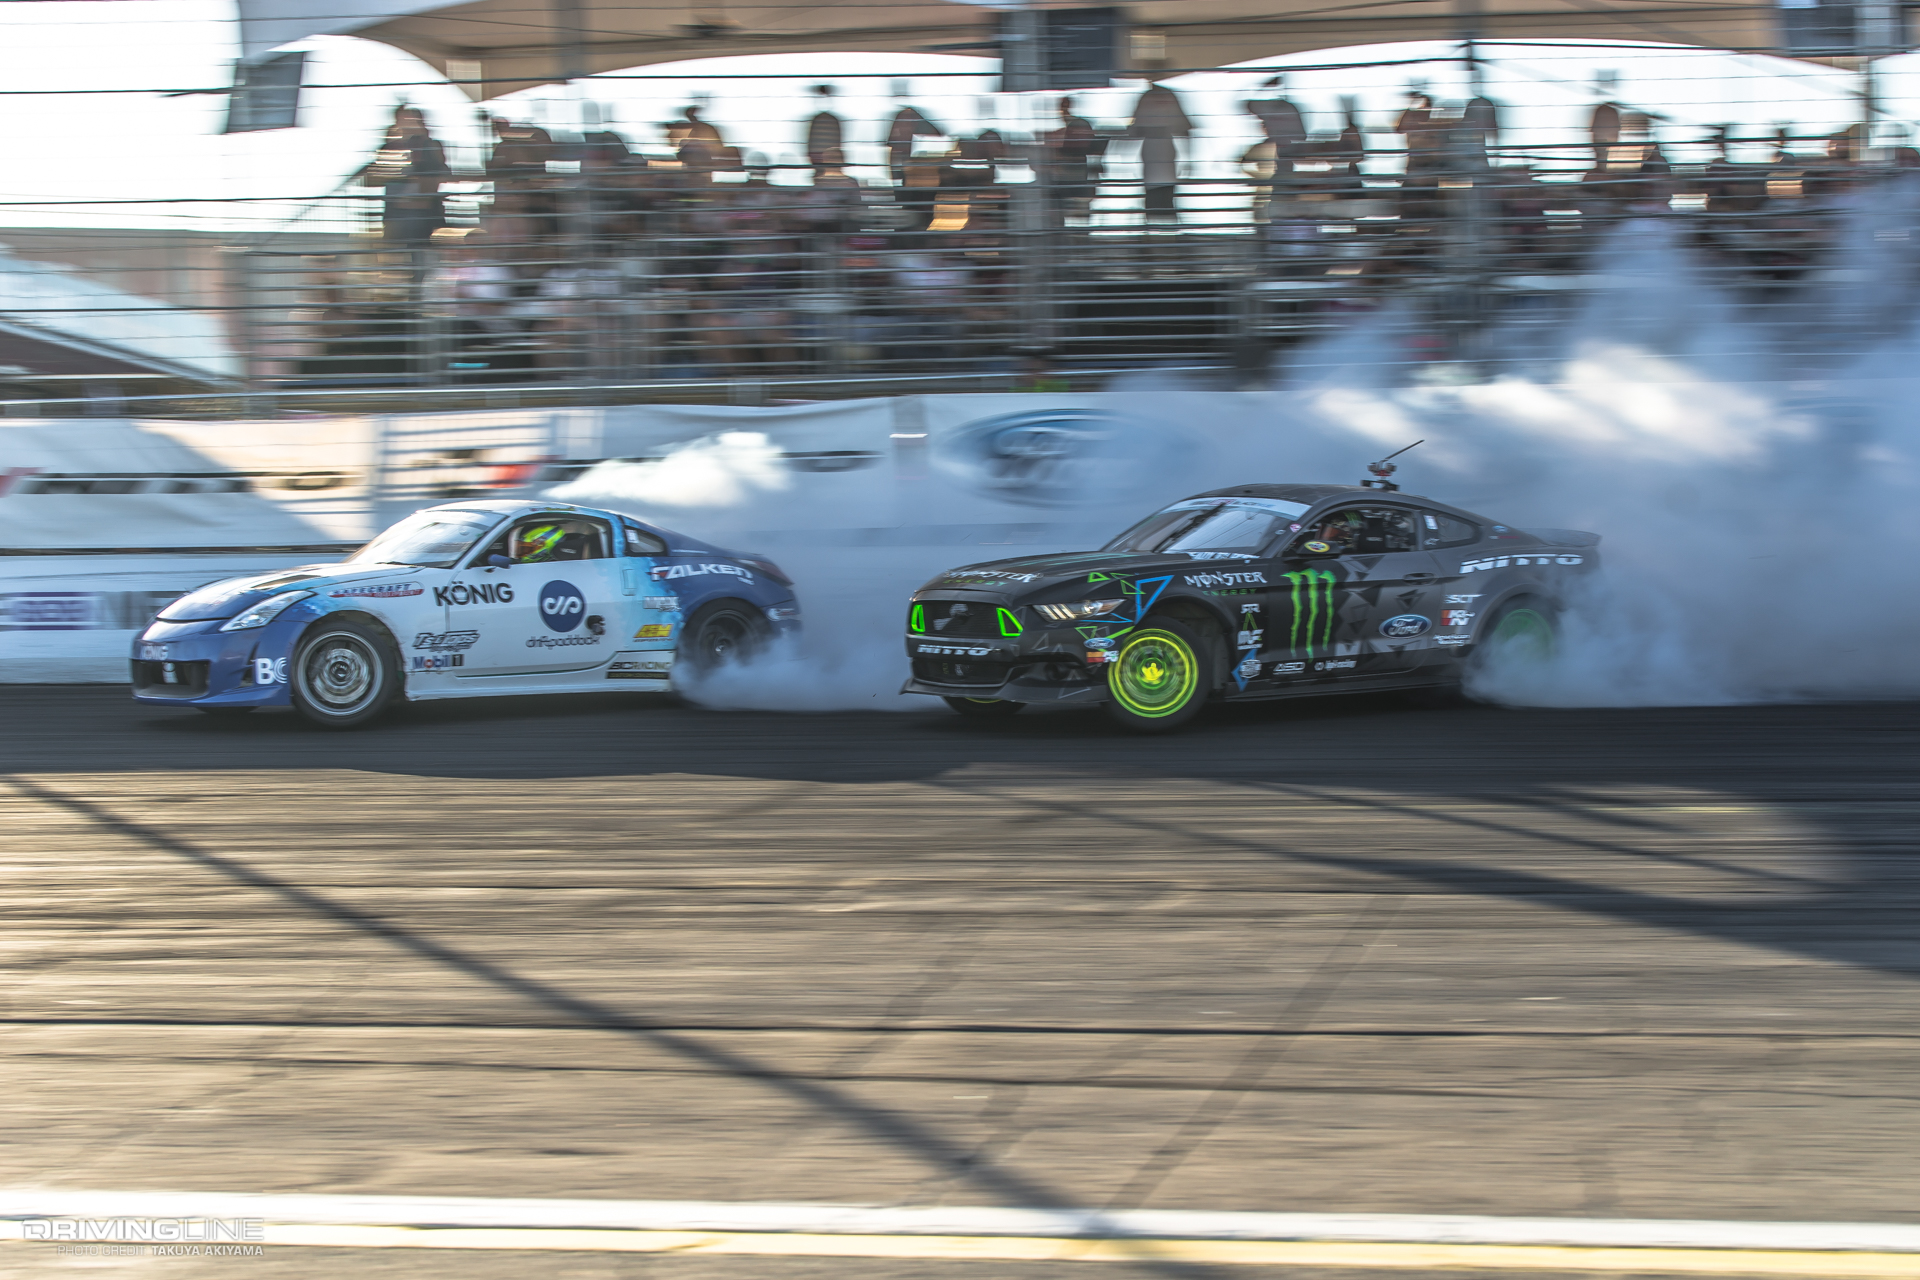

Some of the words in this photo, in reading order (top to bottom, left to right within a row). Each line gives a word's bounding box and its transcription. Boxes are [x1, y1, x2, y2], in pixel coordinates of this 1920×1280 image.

[650, 563, 753, 581] FALKEN
[1459, 553, 1583, 574] NITTO
[1184, 570, 1267, 588] MONSTER
[432, 580, 514, 606] KÖNIG
[1201, 588, 1255, 597] ENERGY
[1388, 618, 1423, 636] Ford
[917, 644, 989, 656] NITTO
[413, 655, 450, 669] Mobil
